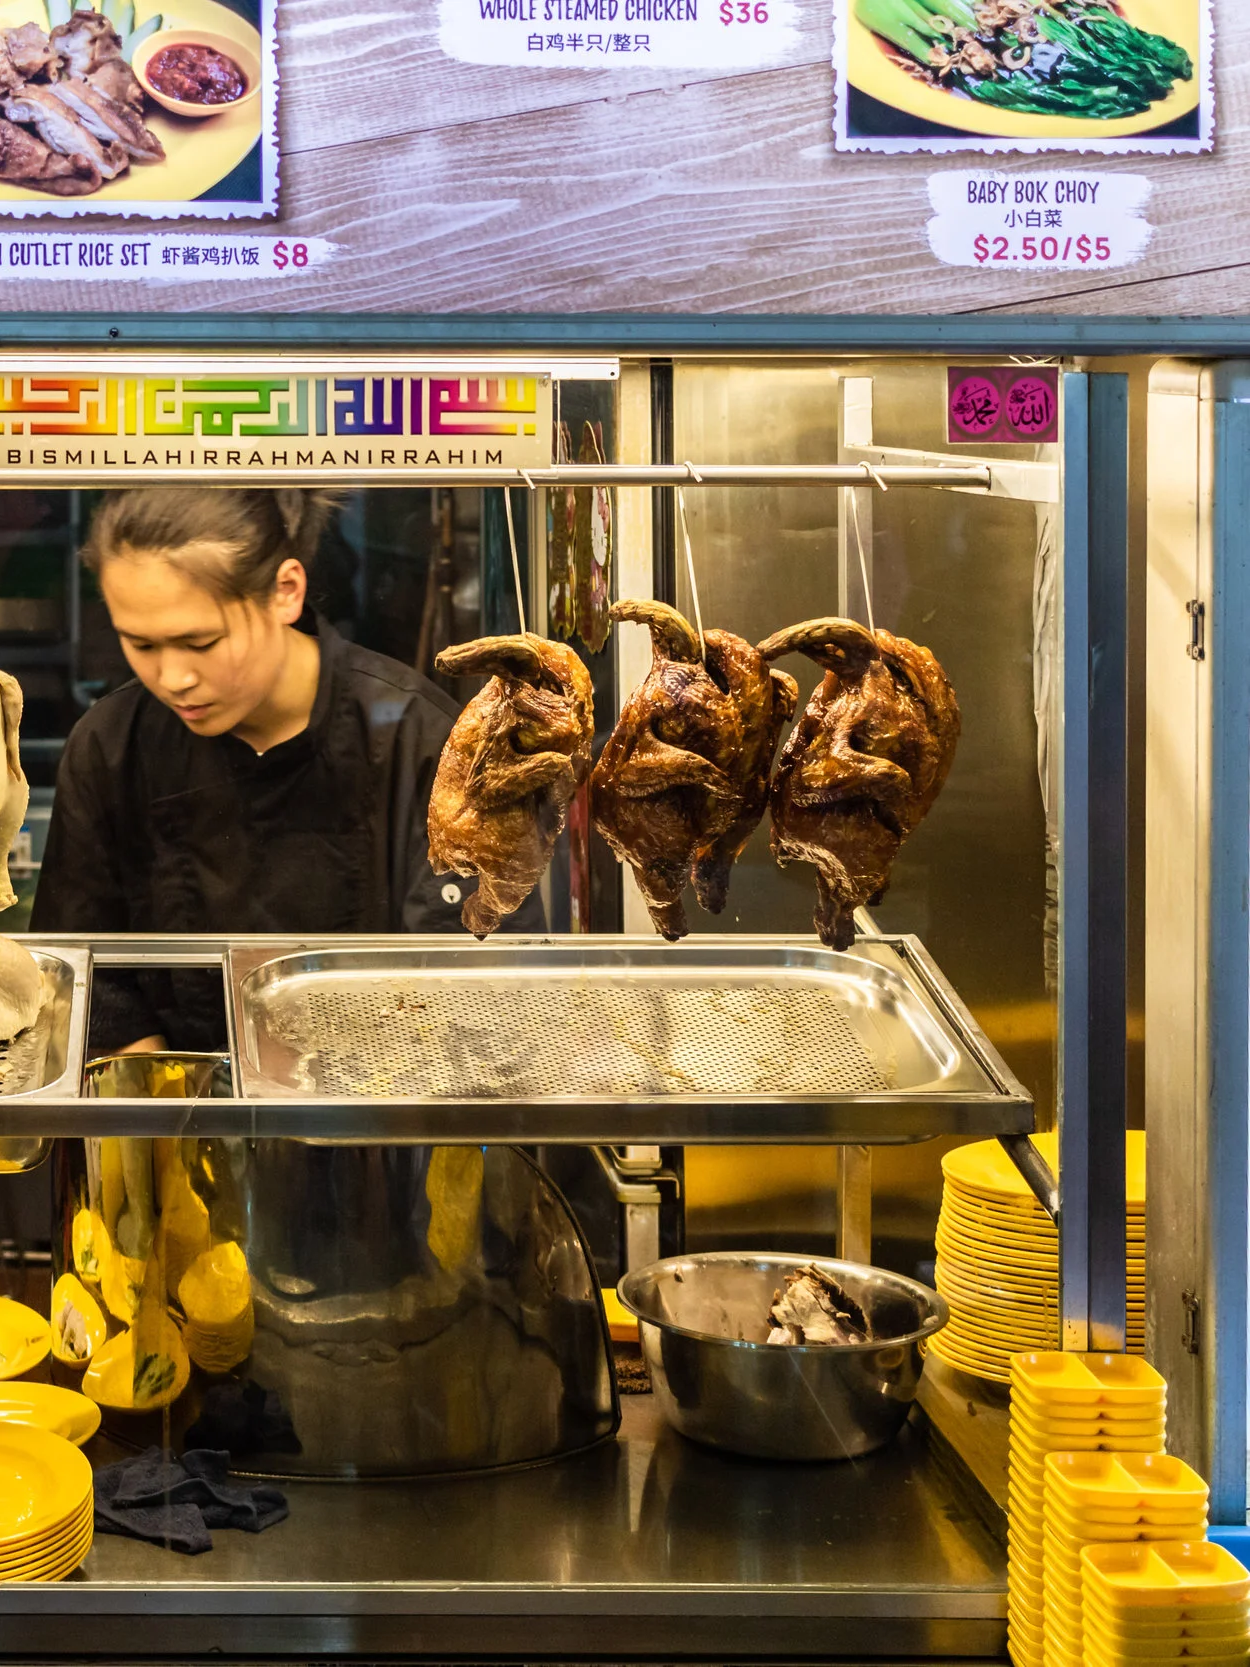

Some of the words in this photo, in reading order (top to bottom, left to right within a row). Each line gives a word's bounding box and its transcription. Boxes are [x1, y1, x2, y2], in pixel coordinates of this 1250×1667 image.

[479, 0, 537, 21] WHOLE
[544, 0, 618, 21] STEAMED
[625, 0, 697, 21] CHICKEN
[719, 0, 769, 26] $36
[527, 32, 651, 53] 白鸡半只/整只
[968, 180, 1009, 204] BABY
[1015, 180, 1048, 204] BOK
[1055, 180, 1100, 204] CHOY
[1004, 209, 1063, 228] 小白菜
[10, 242, 72, 267] CUTLET
[78, 243, 114, 267] RICE
[121, 243, 151, 267] SET
[161, 246, 260, 266] 虾酱鸡扒饭
[272, 241, 309, 271] $8
[973, 234, 1111, 263] $2.50/$5
[7, 449, 502, 466] BISMILLAHIRRAHMANIRRAHIM
